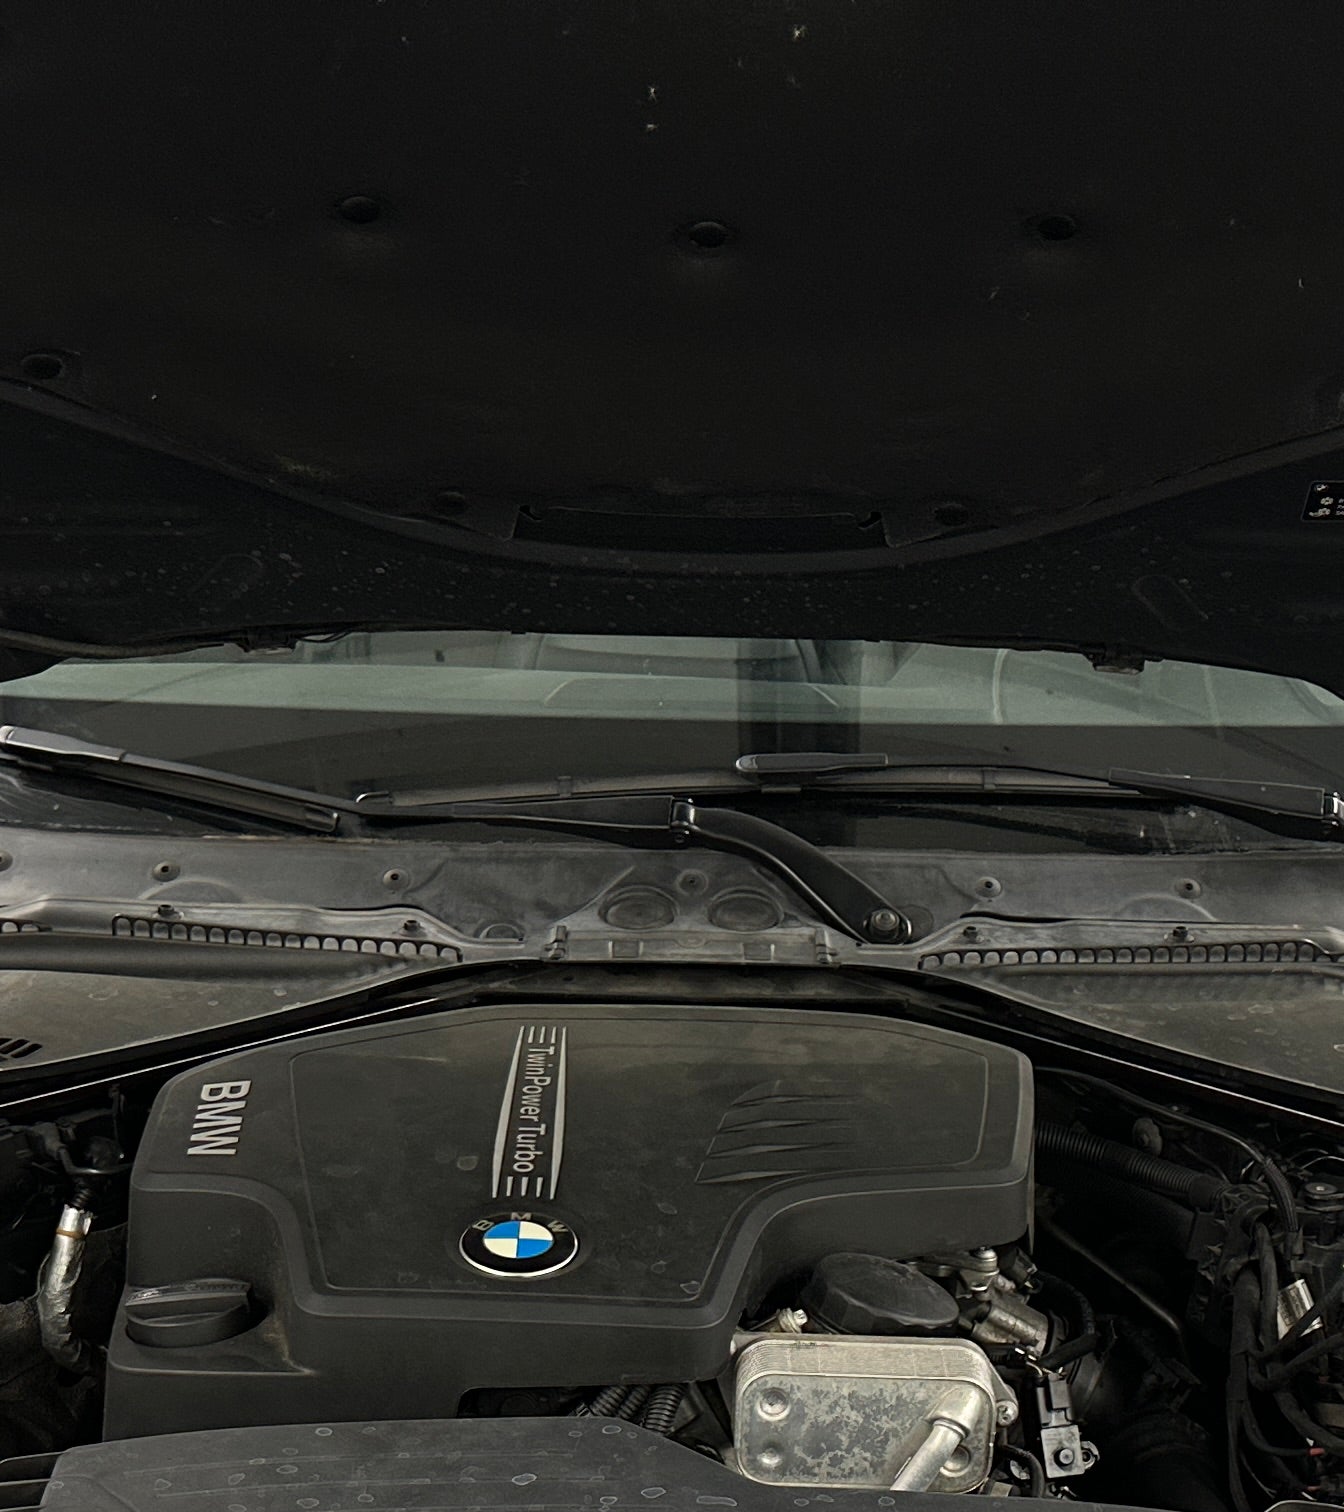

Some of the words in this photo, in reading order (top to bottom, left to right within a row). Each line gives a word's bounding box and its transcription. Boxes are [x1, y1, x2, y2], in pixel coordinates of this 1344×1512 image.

[520, 1046, 555, 1122] TwinPower
[187, 1080, 251, 1155] BMW
[513, 1123, 546, 1173] Turbo
[472, 1212, 569, 1232] BMW
